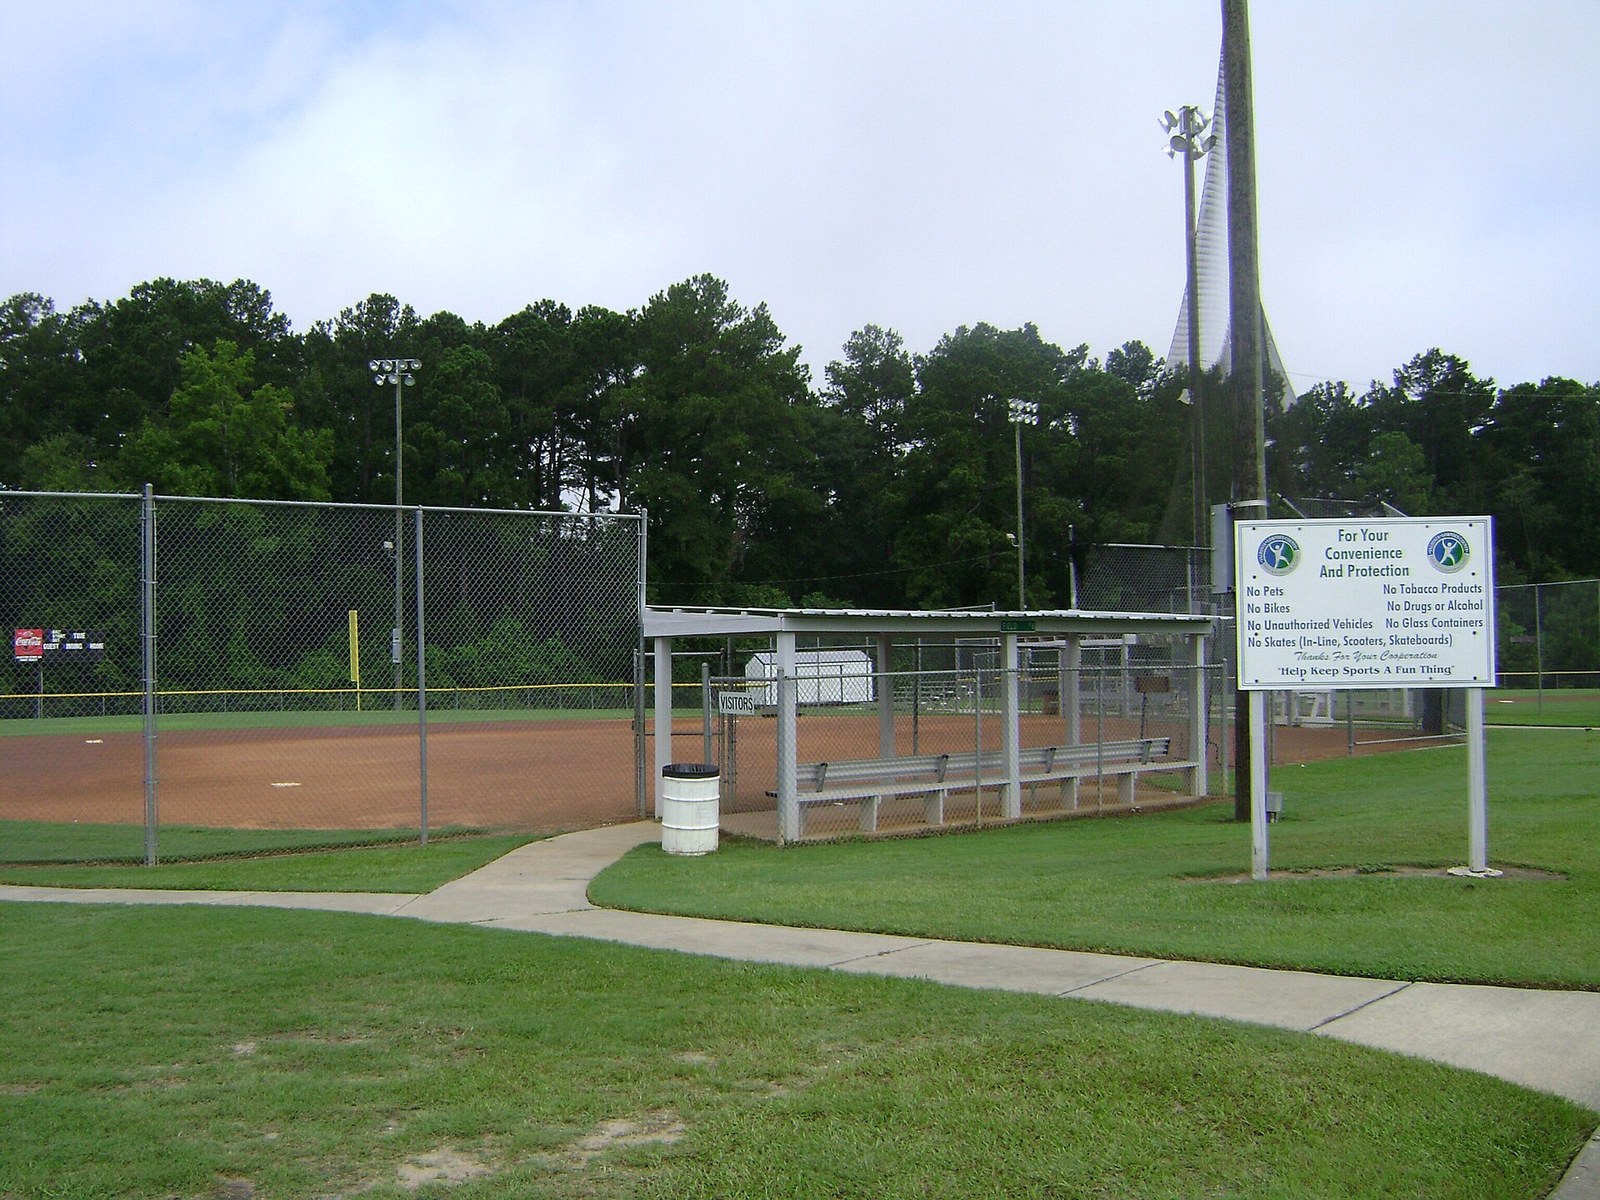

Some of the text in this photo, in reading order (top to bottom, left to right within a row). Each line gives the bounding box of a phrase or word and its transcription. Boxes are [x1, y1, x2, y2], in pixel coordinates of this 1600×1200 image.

[1338, 528, 1389, 542] For Your
[1325, 547, 1403, 560] Convenience
[1320, 564, 1409, 578] And Protection
[1247, 586, 1284, 597] No Pets
[1383, 582, 1482, 594] No Tobacco Products
[1247, 603, 1290, 614] No Bikes
[1387, 599, 1483, 613] No Drugs or Alcohol
[1247, 618, 1373, 631] No Unauthorized Vehicles
[1385, 617, 1483, 628] No Glass Containers
[1248, 634, 1453, 649] No Skates (In-Line, Scooters, Skateboards)
[1294, 650, 1438, 663] Thanks For Your Cooperation
[1310, 667, 1339, 676] Keep
[1342, 666, 1380, 677] Sports
[1384, 666, 1391, 674] A
[1395, 666, 1416, 674] Fun
[720, 696, 753, 710] VISITORS
